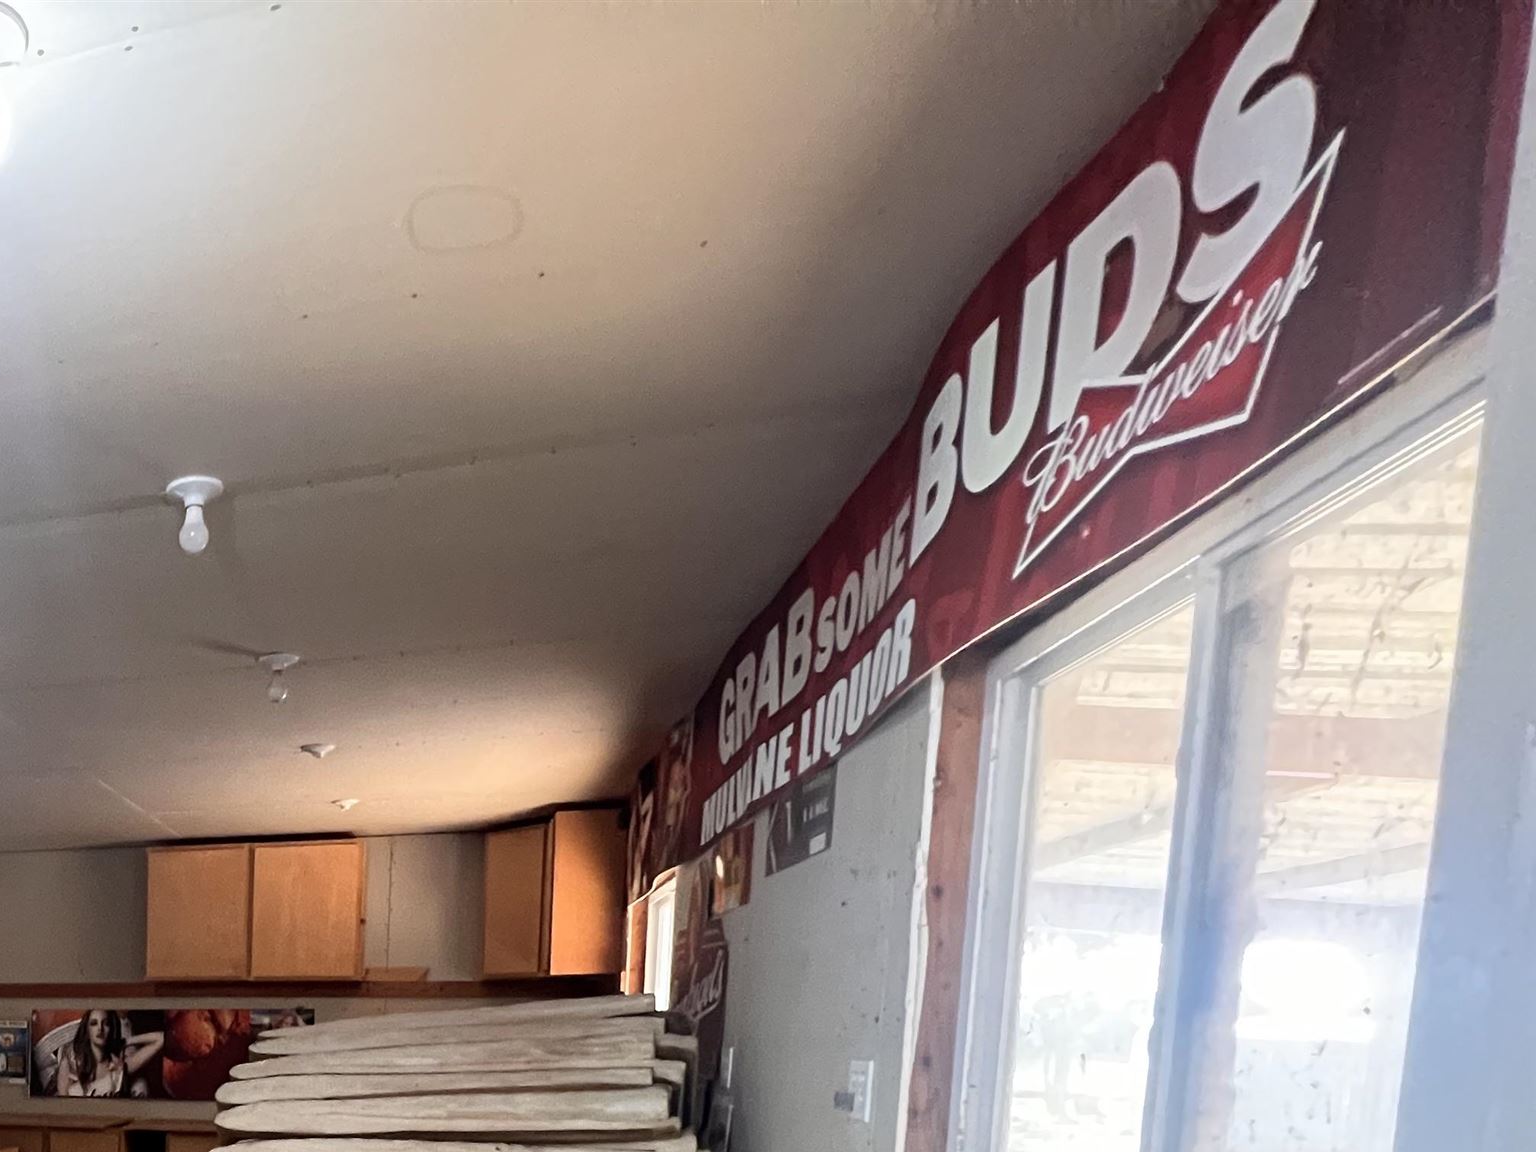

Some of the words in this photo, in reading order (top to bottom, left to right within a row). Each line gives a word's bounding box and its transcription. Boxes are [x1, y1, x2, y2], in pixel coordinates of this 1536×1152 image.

[718, 586, 814, 766] GRAB
[814, 494, 913, 673] SOME
[909, 0, 1319, 569] BUDS
[1024, 241, 1323, 525] Budweiser
[798, 598, 916, 776] LIQUOR
